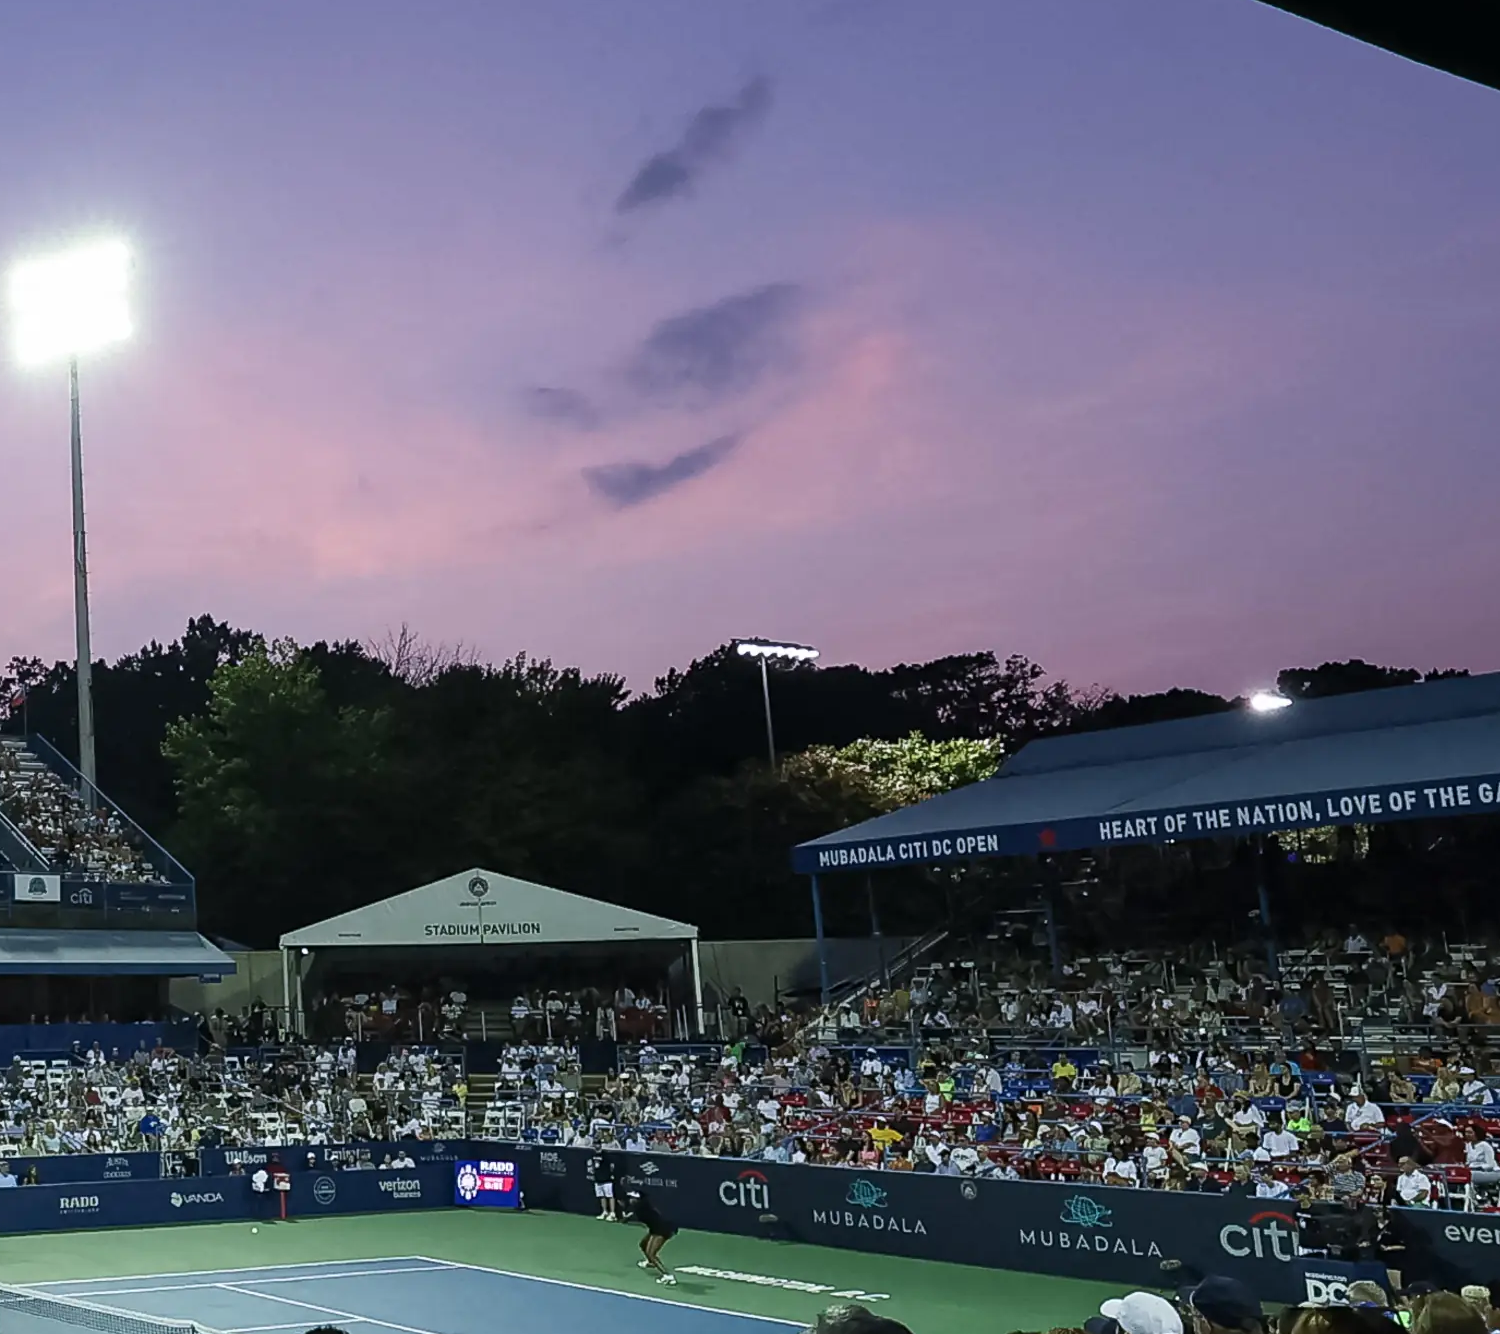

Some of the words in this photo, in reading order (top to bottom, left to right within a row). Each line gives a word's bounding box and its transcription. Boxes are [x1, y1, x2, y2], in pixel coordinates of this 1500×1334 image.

[1100, 817, 1157, 840] HEART
[1164, 813, 1187, 833] OF
[1194, 809, 1230, 830] THE
[1236, 801, 1321, 827] NATION,
[1327, 794, 1382, 818] LOVE
[1389, 791, 1416, 811] OF
[1425, 785, 1470, 809] THE
[819, 845, 895, 867] MUBADALA
[899, 841, 928, 860] CITI
[932, 838, 952, 856] DC
[956, 835, 999, 854] OPEN
[70, 889, 93, 905] citi
[425, 924, 479, 936] STADIUM
[483, 922, 541, 935] PAVILION
[224, 1151, 267, 1165] Wilson
[480, 1160, 515, 1171] RADO
[378, 1178, 421, 1193] verizon
[718, 1177, 770, 1209] citi
[60, 1195, 99, 1209] RADO
[183, 1192, 224, 1205] VANDA
[812, 1208, 928, 1236] MUBADALA
[1020, 1228, 1164, 1258] MUBADALA
[1219, 1220, 1299, 1263] citi
[1306, 1280, 1350, 1305] DC
